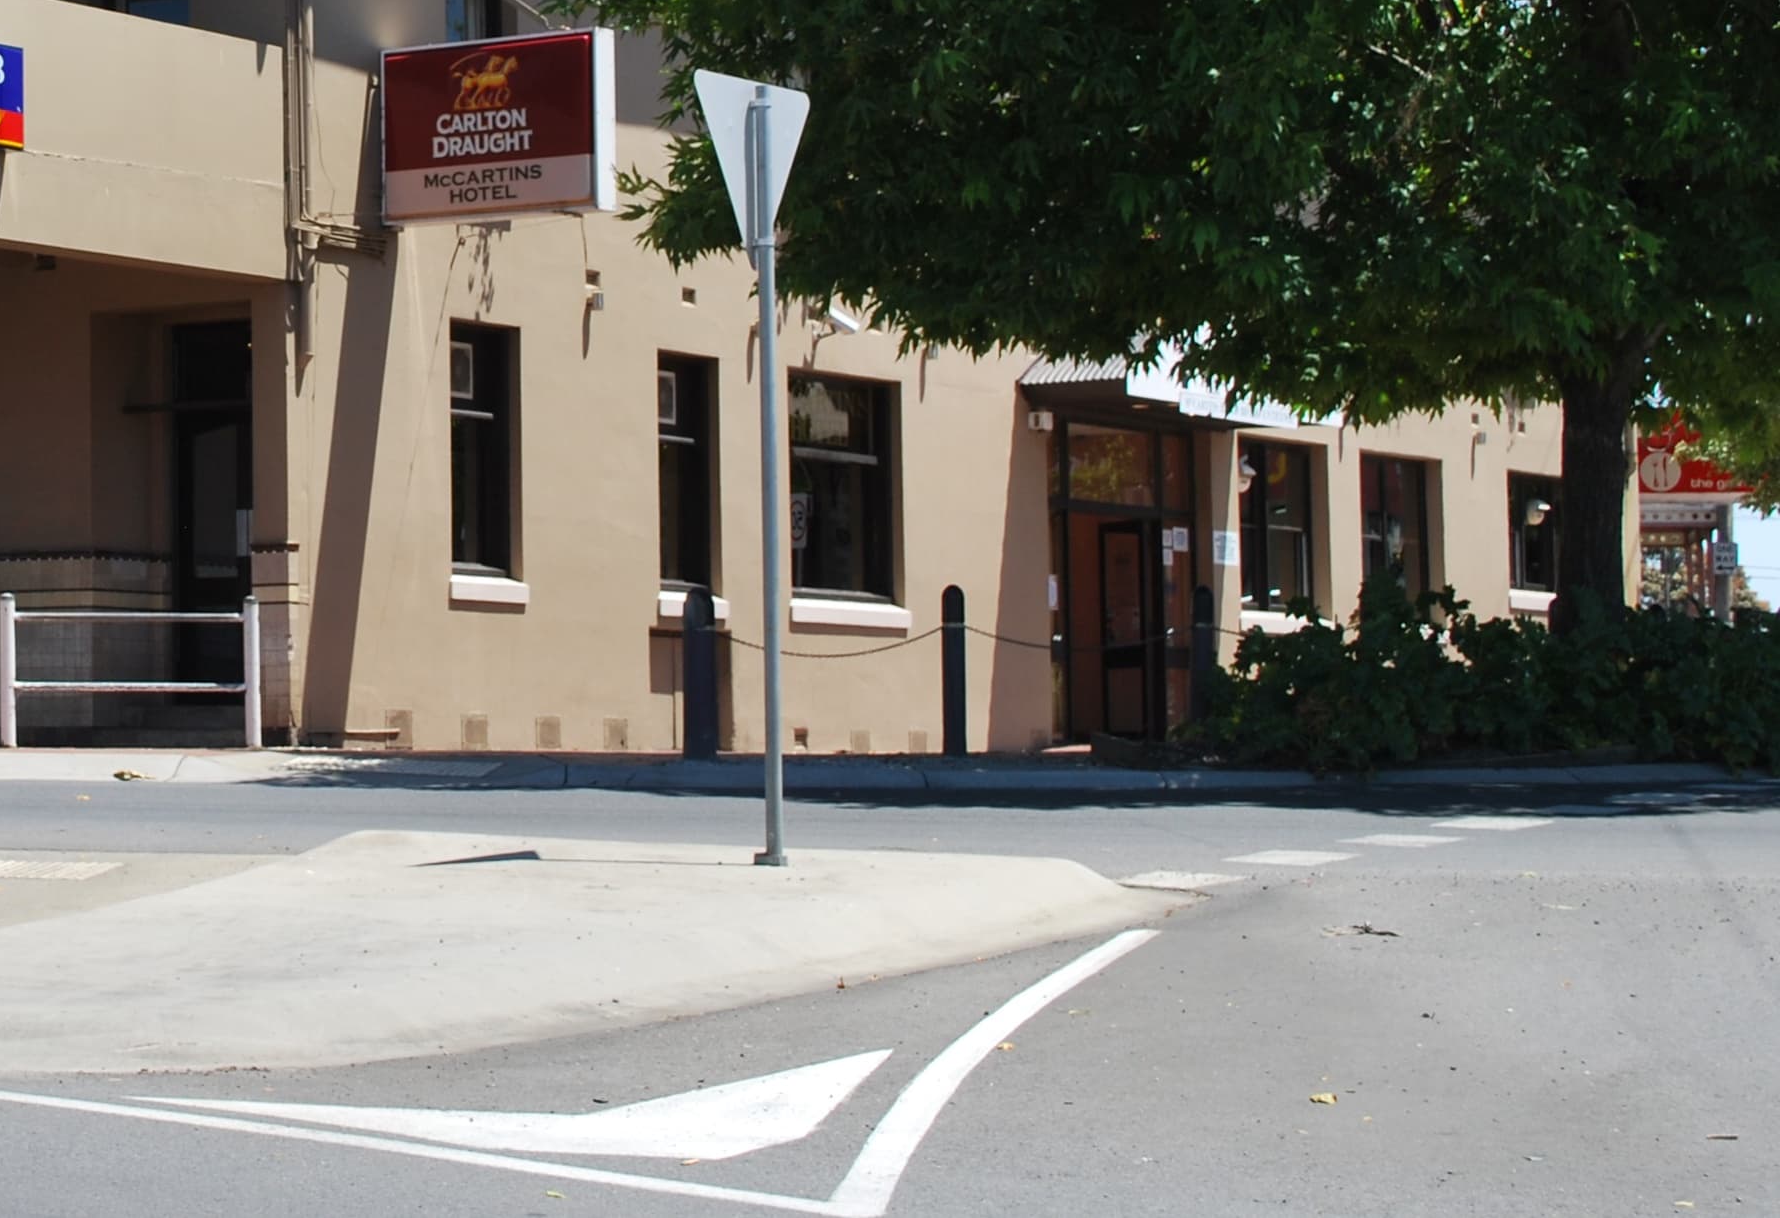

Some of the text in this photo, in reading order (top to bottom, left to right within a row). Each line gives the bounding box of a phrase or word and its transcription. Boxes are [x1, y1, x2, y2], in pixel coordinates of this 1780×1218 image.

[436, 107, 527, 135] CARLTON
[432, 129, 533, 159] DRAUGHT
[423, 164, 543, 189] McCARTINS
[449, 185, 518, 204] HOTEL
